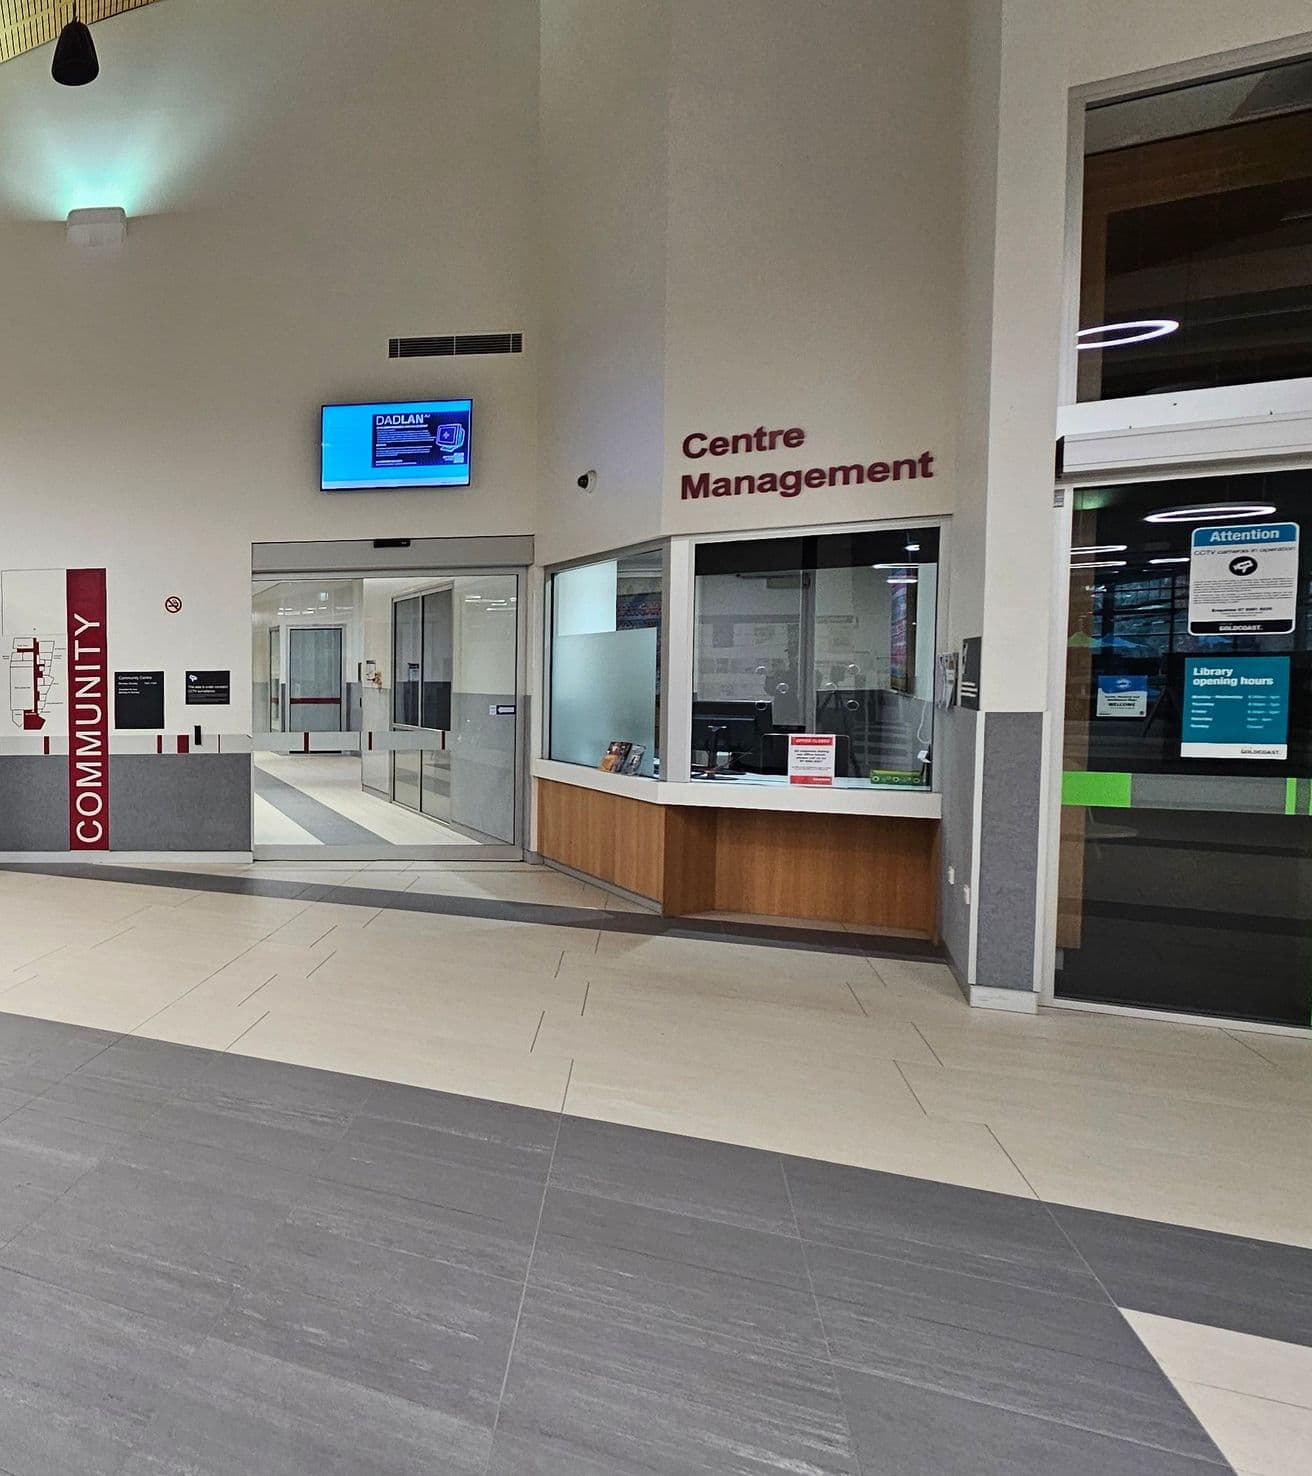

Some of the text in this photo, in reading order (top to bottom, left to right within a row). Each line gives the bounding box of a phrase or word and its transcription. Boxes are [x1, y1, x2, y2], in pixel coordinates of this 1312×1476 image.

[376, 414, 424, 425] DADLAN
[682, 426, 805, 459] Centre
[681, 451, 934, 500] Management
[1210, 529, 1280, 543] Attention
[1193, 667, 1233, 677] Library
[1192, 677, 1274, 687] opening hours
[74, 613, 103, 843] COMMUNITY
